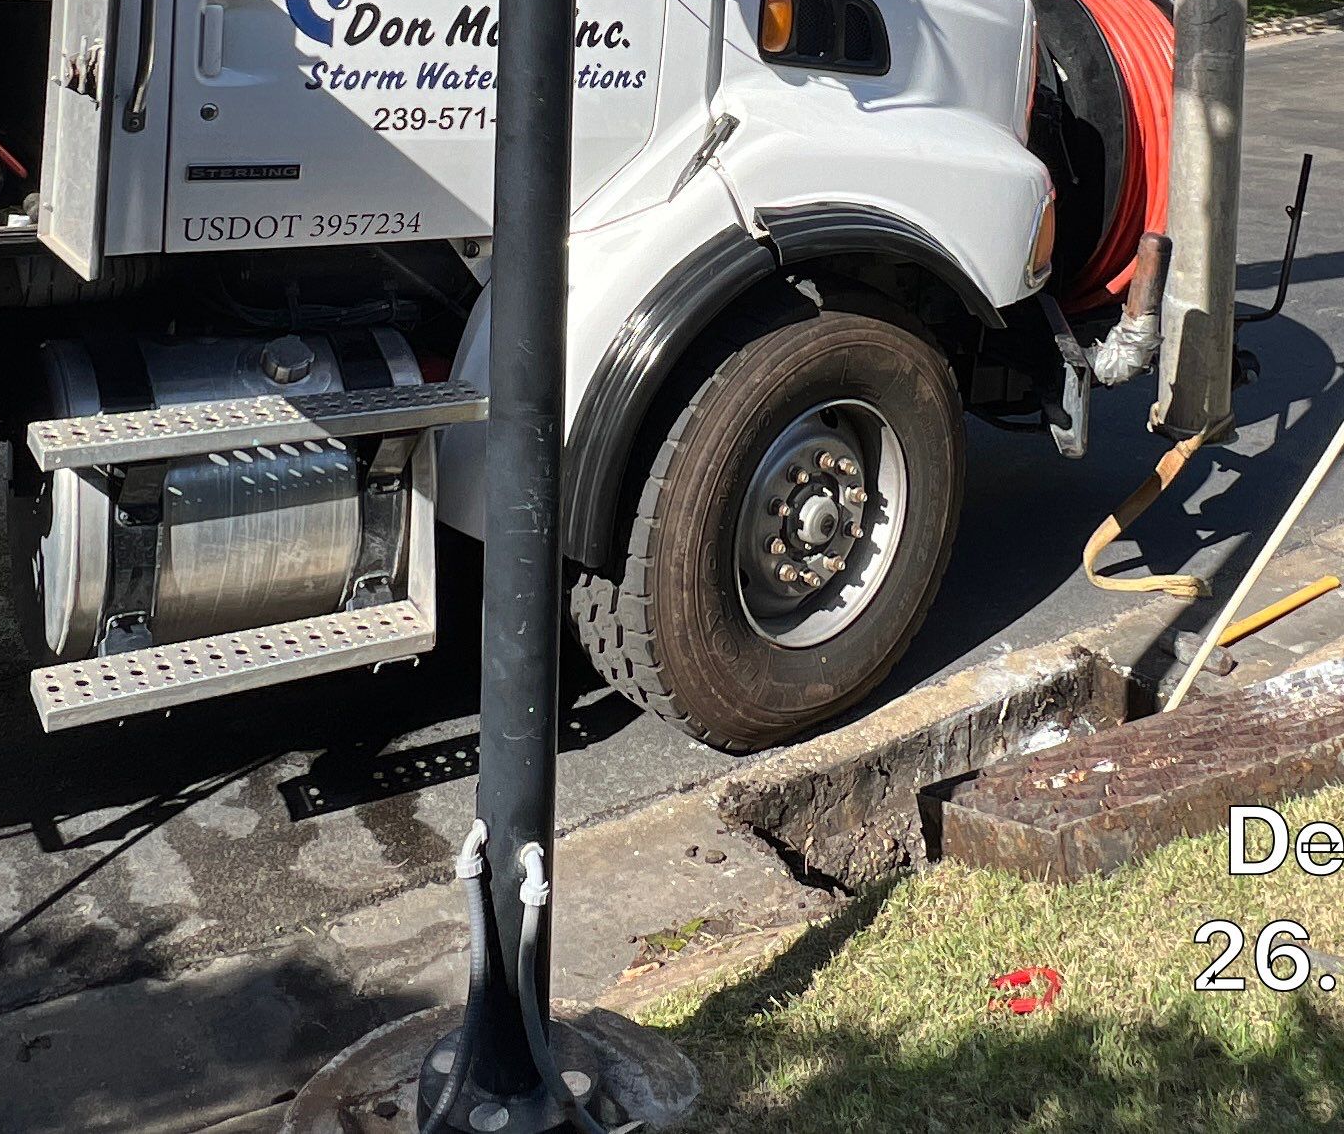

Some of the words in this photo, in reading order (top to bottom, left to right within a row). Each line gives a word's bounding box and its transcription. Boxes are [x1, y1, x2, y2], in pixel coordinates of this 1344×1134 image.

[343, 2, 435, 48] Don
[445, 4, 499, 48] Ma
[575, 7, 631, 49] nc.
[304, 60, 408, 91] Storm
[576, 63, 647, 89] tions
[191, 167, 298, 178] STERLING
[183, 214, 302, 242] USDOT
[310, 211, 422, 238] 3957234
